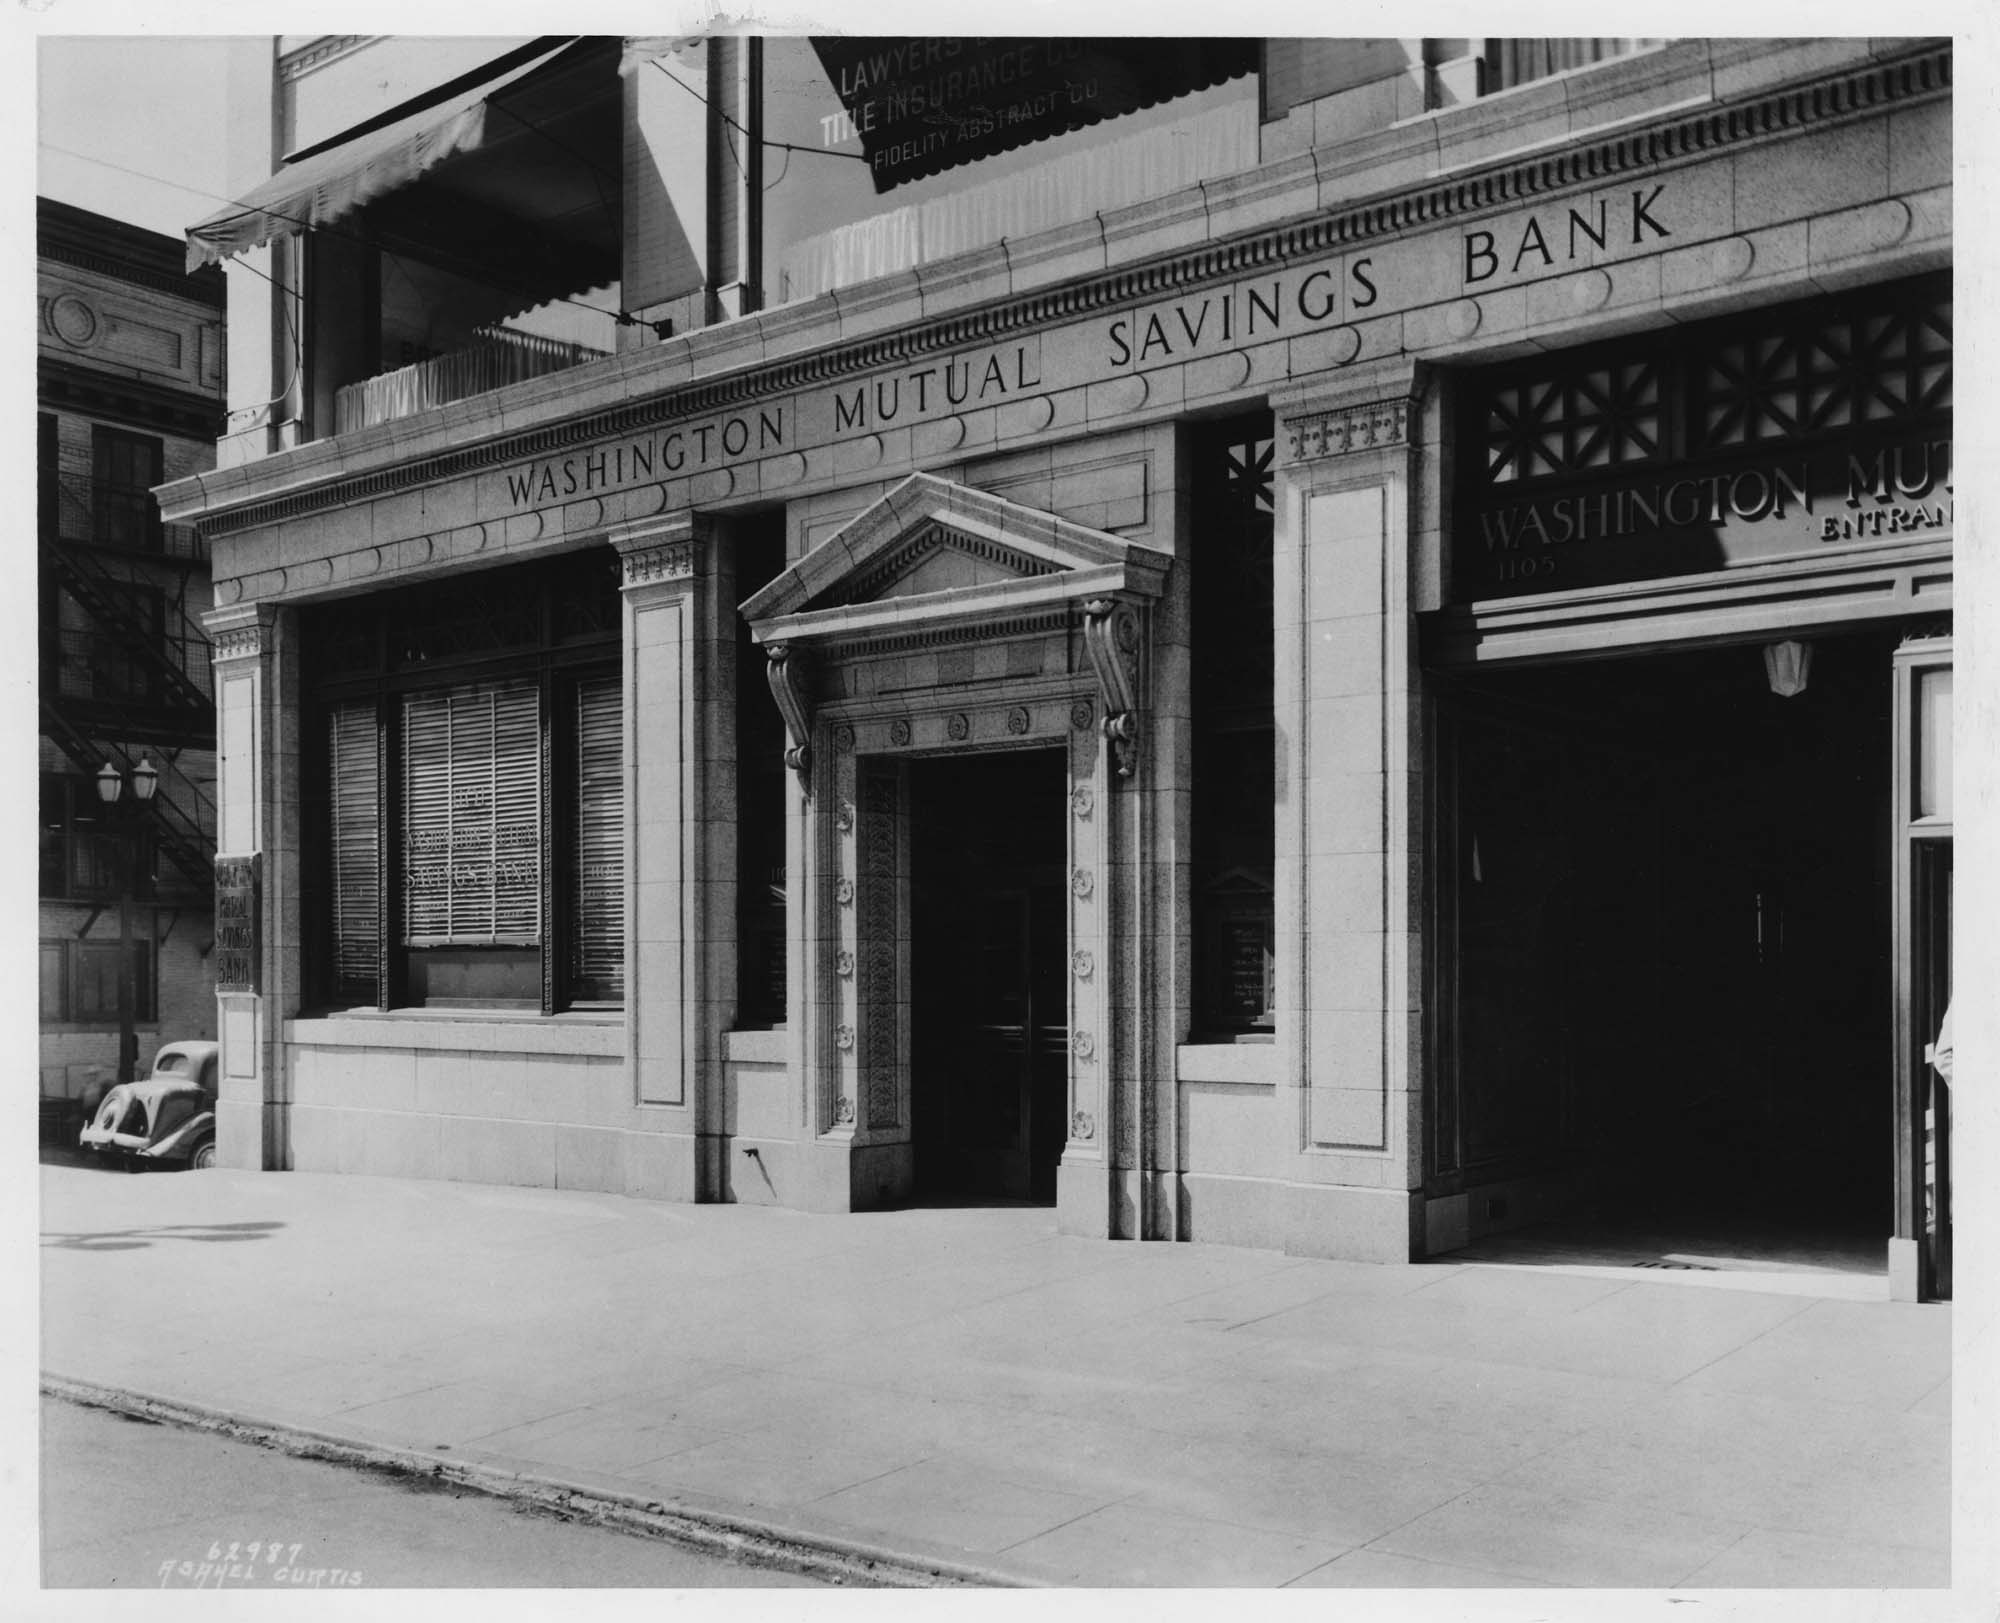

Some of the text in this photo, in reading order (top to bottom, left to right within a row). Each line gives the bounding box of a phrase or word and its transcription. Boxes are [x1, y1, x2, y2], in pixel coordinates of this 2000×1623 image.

[820, 99, 876, 147] TITLE
[887, 45, 1034, 124] INSURANCE
[841, 37, 962, 97] LAWYERS
[874, 129, 951, 170] FIDELITY
[957, 92, 1059, 142] ABSTRACT
[508, 185, 1671, 506] WASHINGTON MUTUAL SAVINGS BANK
[1480, 463, 1809, 552] WASHINGTON
[1496, 553, 1557, 583] 1105
[406, 858, 540, 889] SAVINGS BANK
[218, 958, 249, 985] BANK
